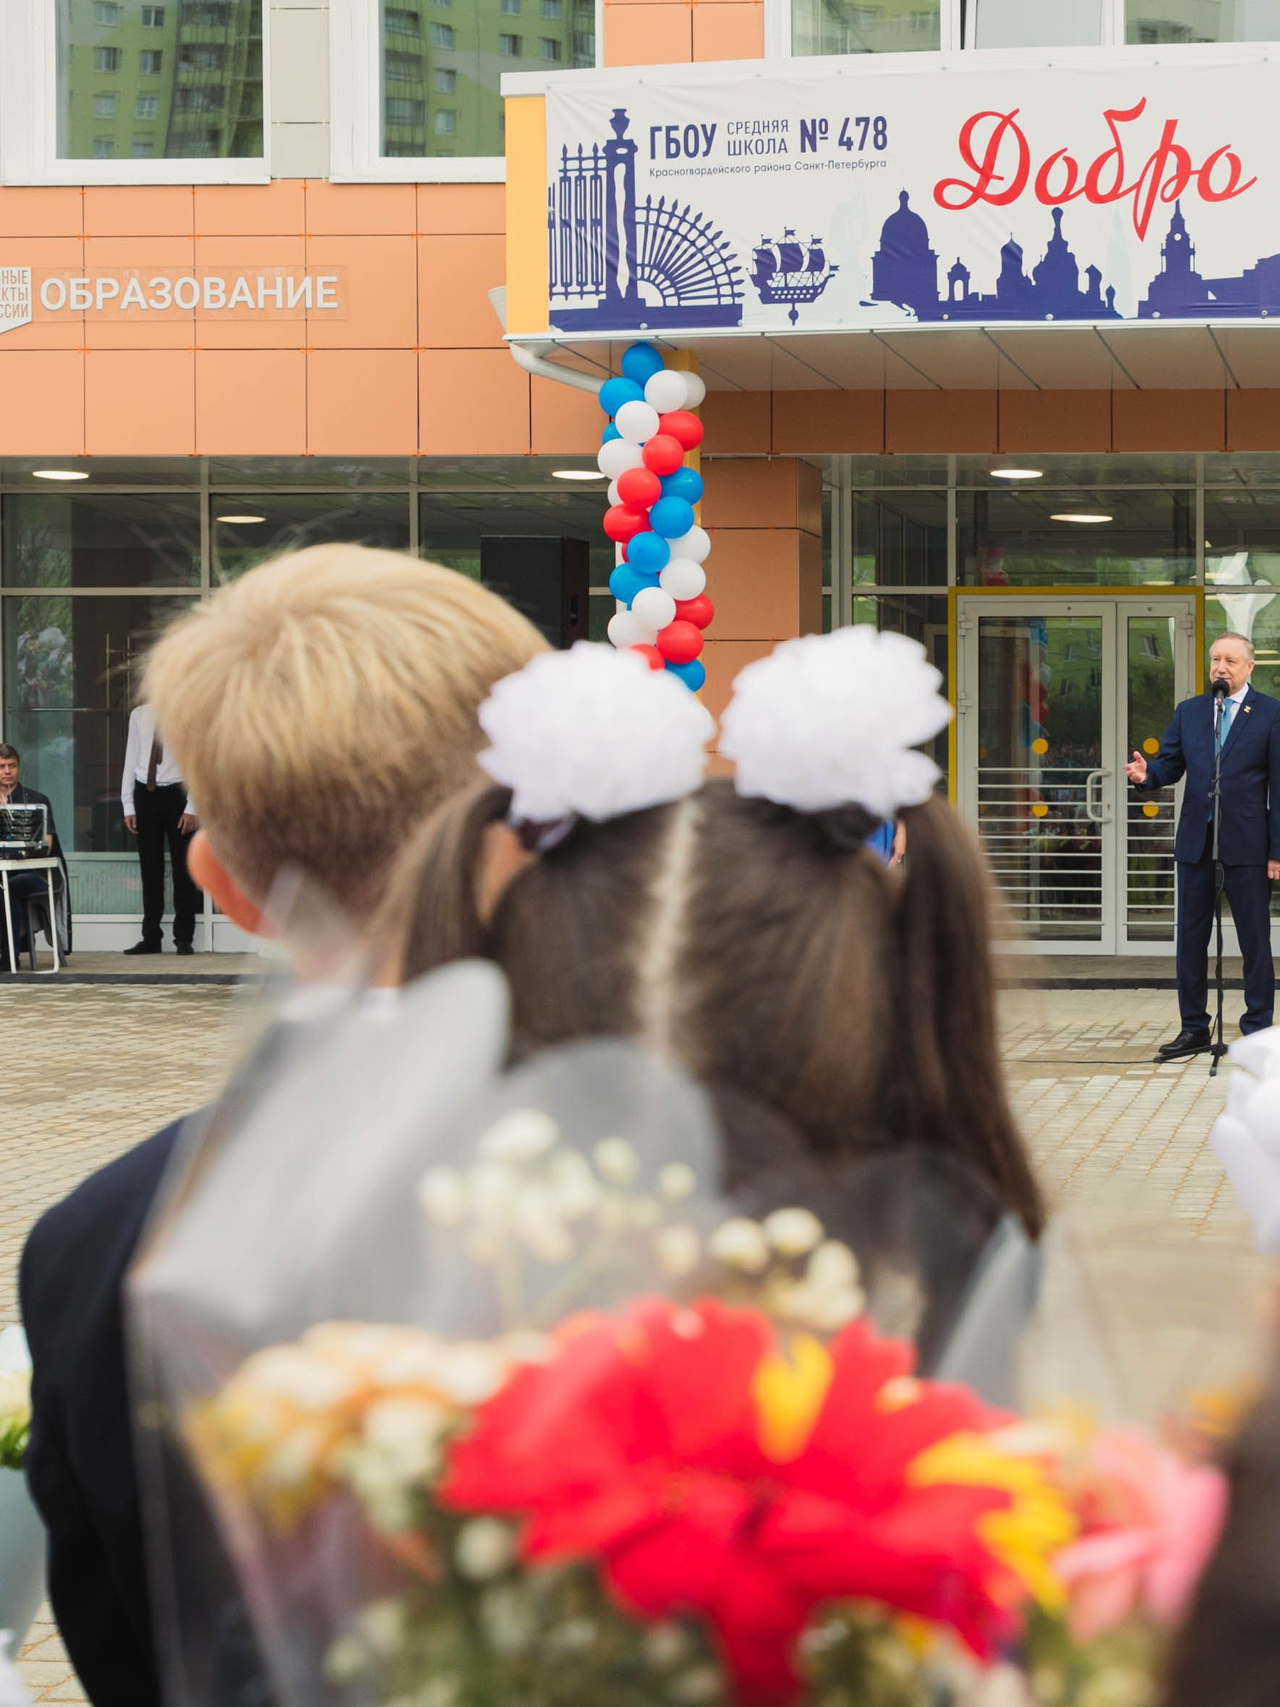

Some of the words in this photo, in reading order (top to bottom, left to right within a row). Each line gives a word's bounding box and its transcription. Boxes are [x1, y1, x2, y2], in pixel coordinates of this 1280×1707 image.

[726, 119, 789, 136] СРЕДНЯЯ
[799, 117, 829, 153] №
[837, 115, 888, 151] 478
[649, 123, 718, 160] ГБОУ
[726, 137, 788, 157] ШКОЛА
[649, 163, 751, 178] Красногвардейского
[754, 161, 792, 174] района
[794, 158, 887, 171] Санкт-Петербурга
[932, 96, 1258, 243] Добро
[0, 270, 29, 285] НЫЕ
[0, 287, 29, 302] КТЫ
[40, 275, 339, 311] ОБРАЗОВАНИЕ
